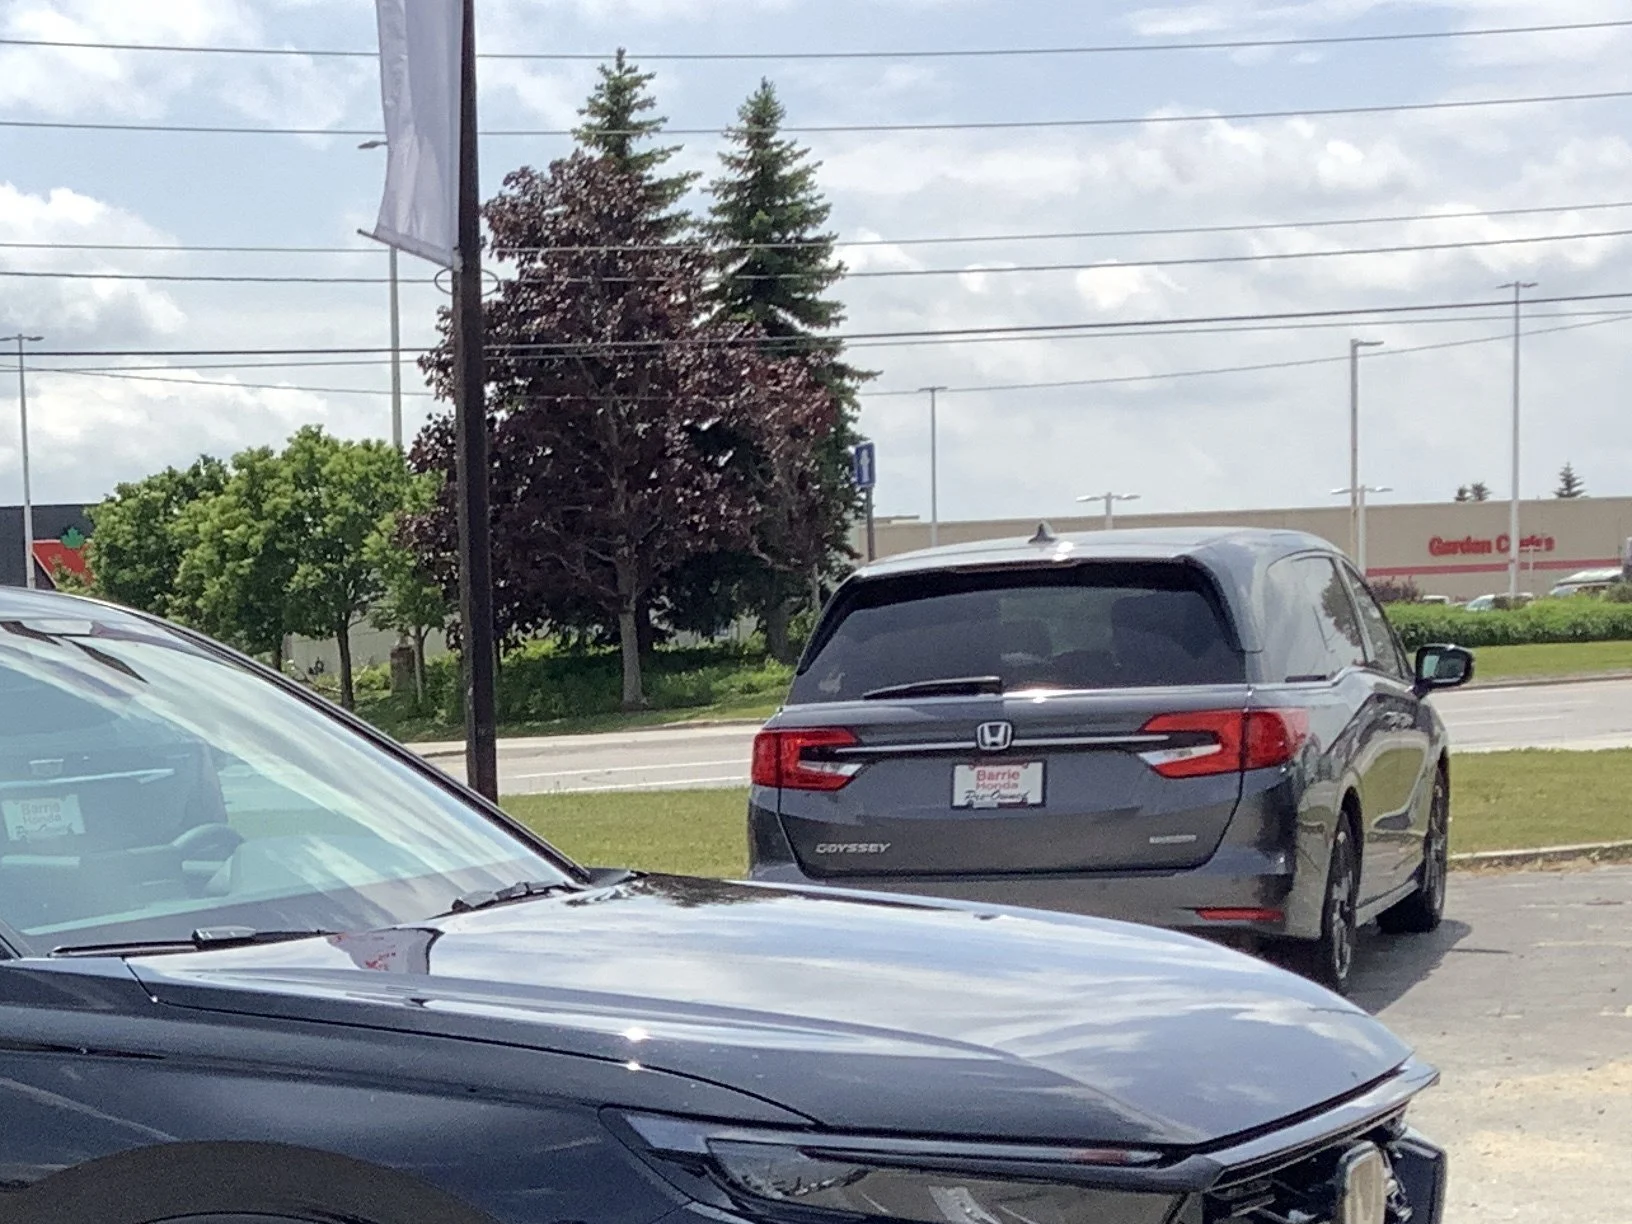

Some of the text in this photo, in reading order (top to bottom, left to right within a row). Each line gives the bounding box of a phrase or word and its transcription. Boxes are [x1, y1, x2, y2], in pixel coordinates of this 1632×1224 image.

[1429, 533, 1555, 556] Garden Cntre
[976, 769, 1020, 781] Barrie
[976, 781, 1019, 790] Honda
[815, 842, 892, 854] ODYSSEY
